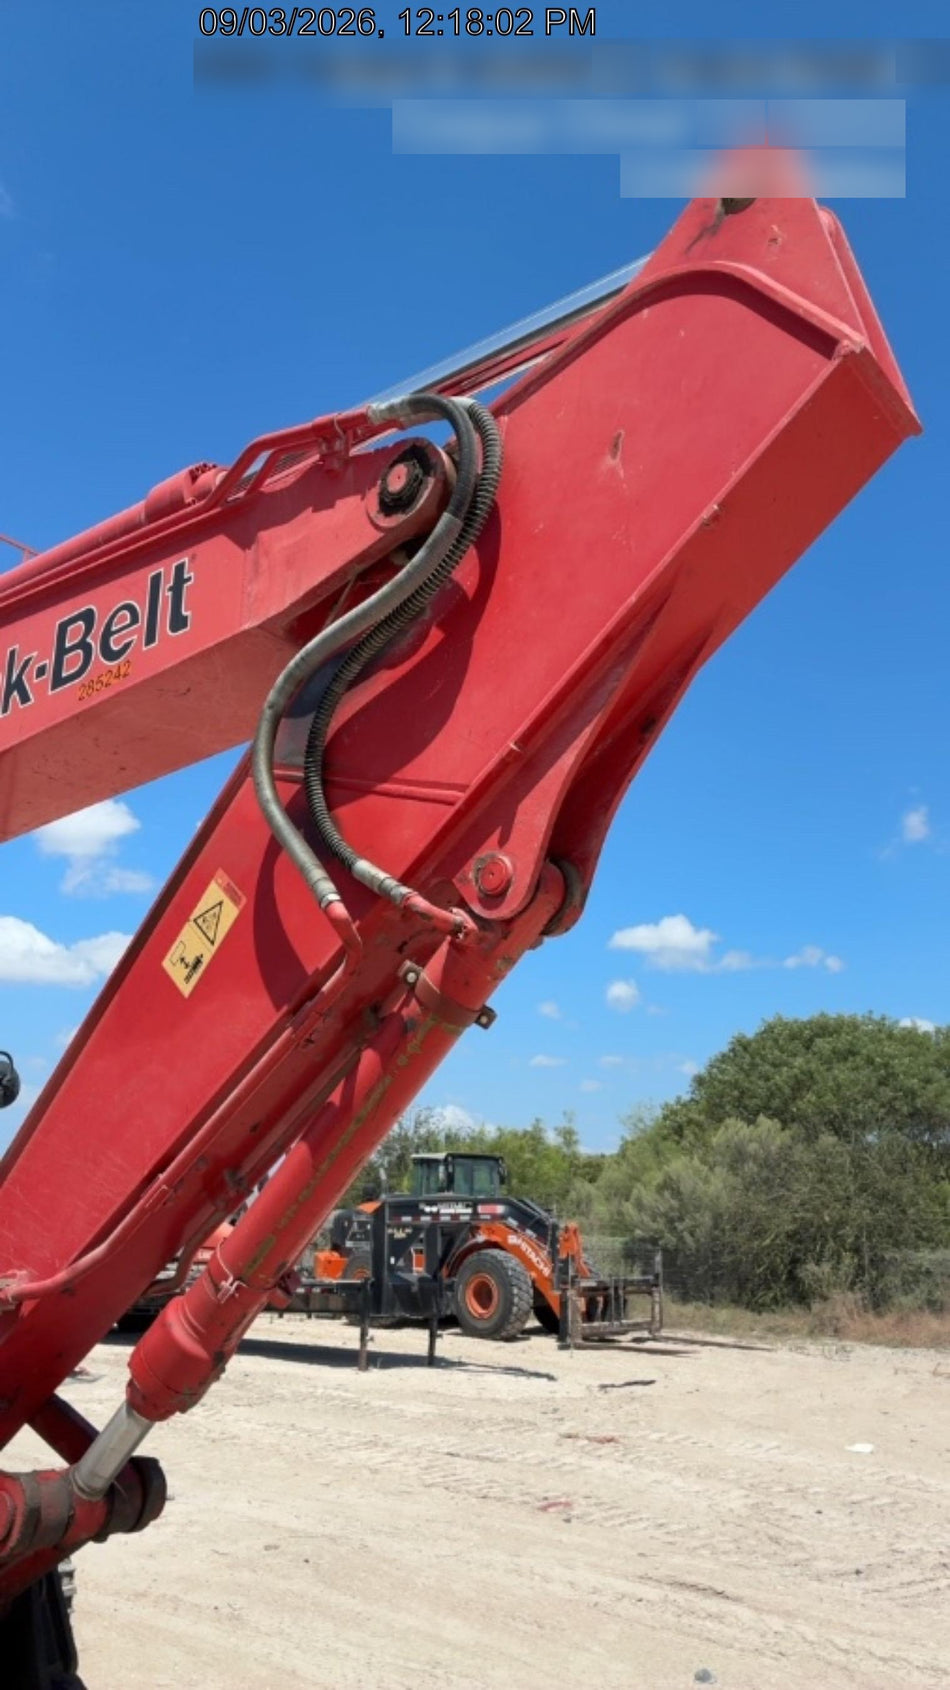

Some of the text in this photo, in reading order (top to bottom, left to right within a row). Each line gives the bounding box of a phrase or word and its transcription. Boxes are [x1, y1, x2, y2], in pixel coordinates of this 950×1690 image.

[0, 557, 194, 717] k-Belt
[78, 659, 131, 701] 285242
[516, 1236, 552, 1278] HITACHI
